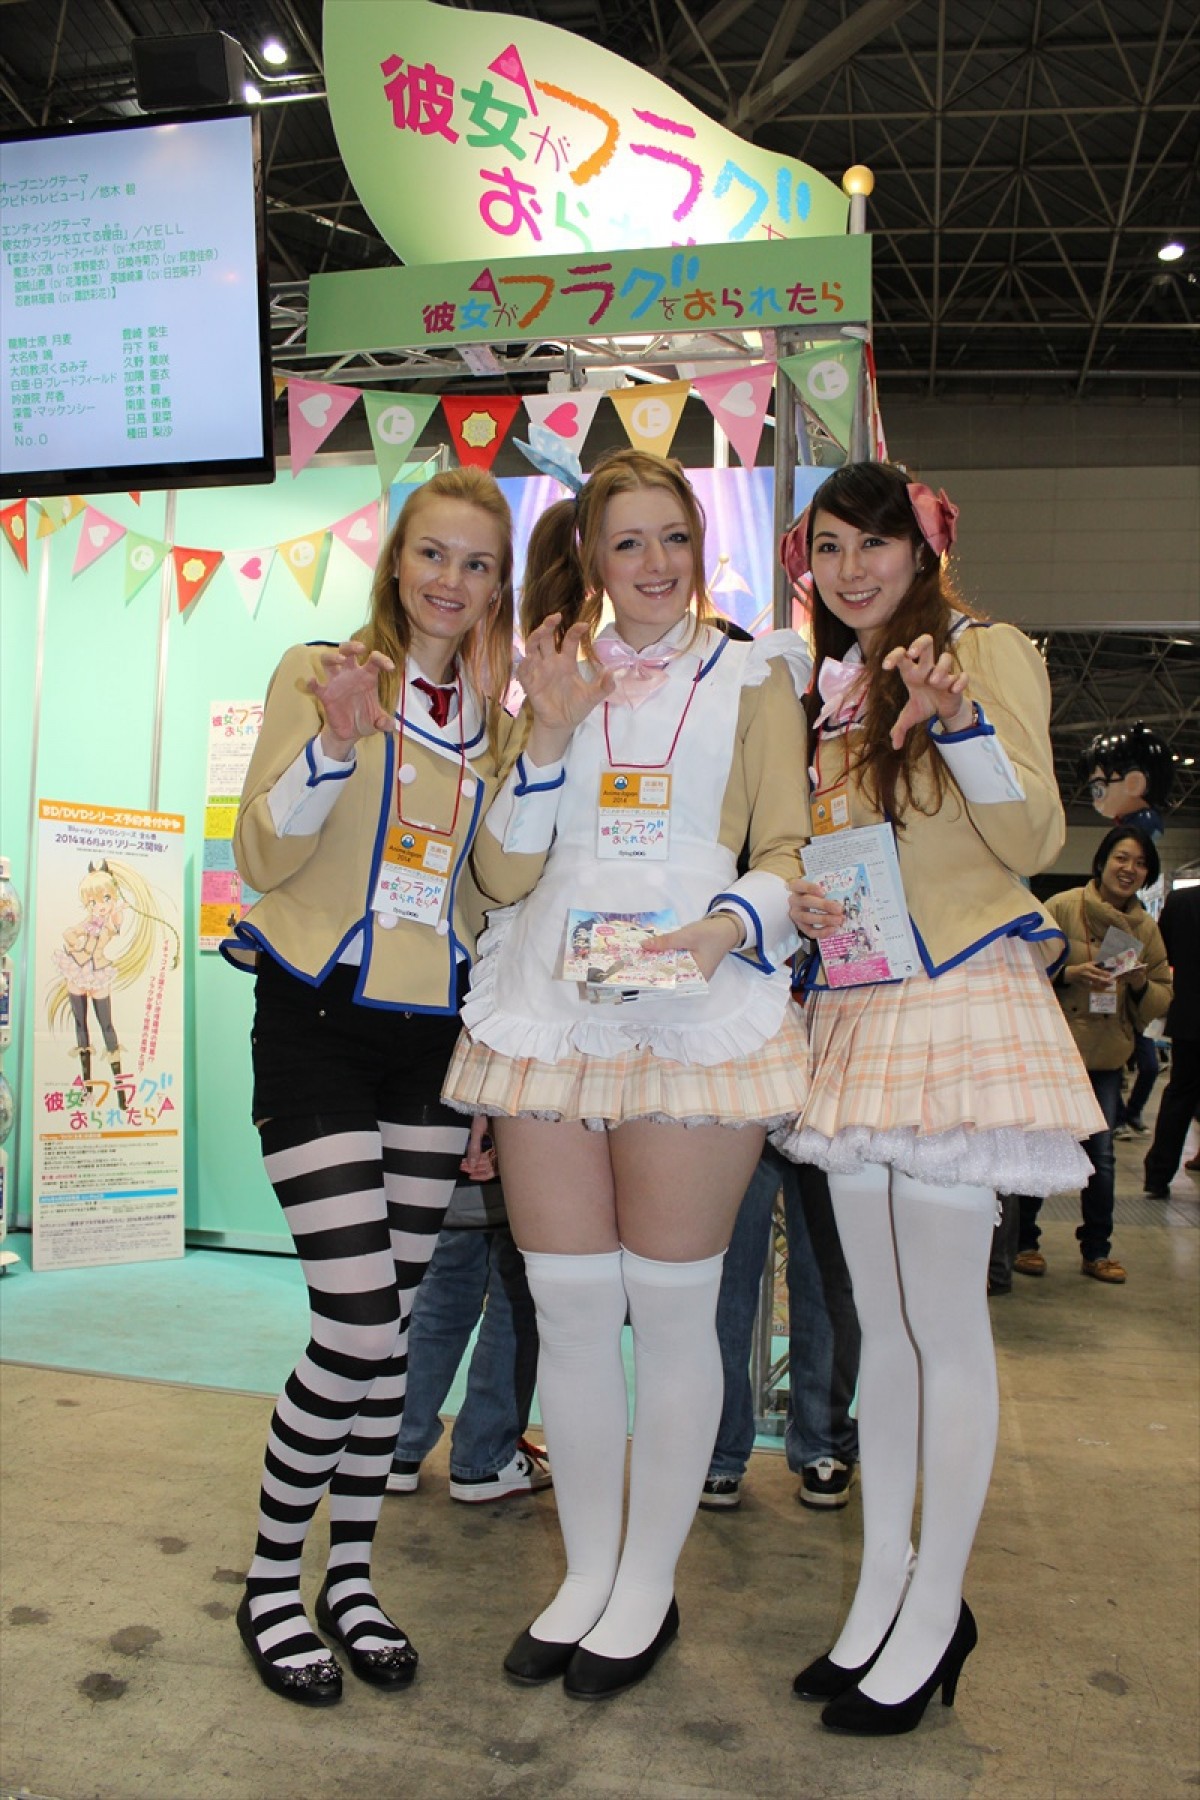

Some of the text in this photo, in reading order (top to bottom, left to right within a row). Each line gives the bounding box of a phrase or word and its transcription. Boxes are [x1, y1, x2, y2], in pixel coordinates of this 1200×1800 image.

[422, 254, 844, 334] 彼女がフラグをおられたら
[70, 1107, 157, 1130] おられたら
